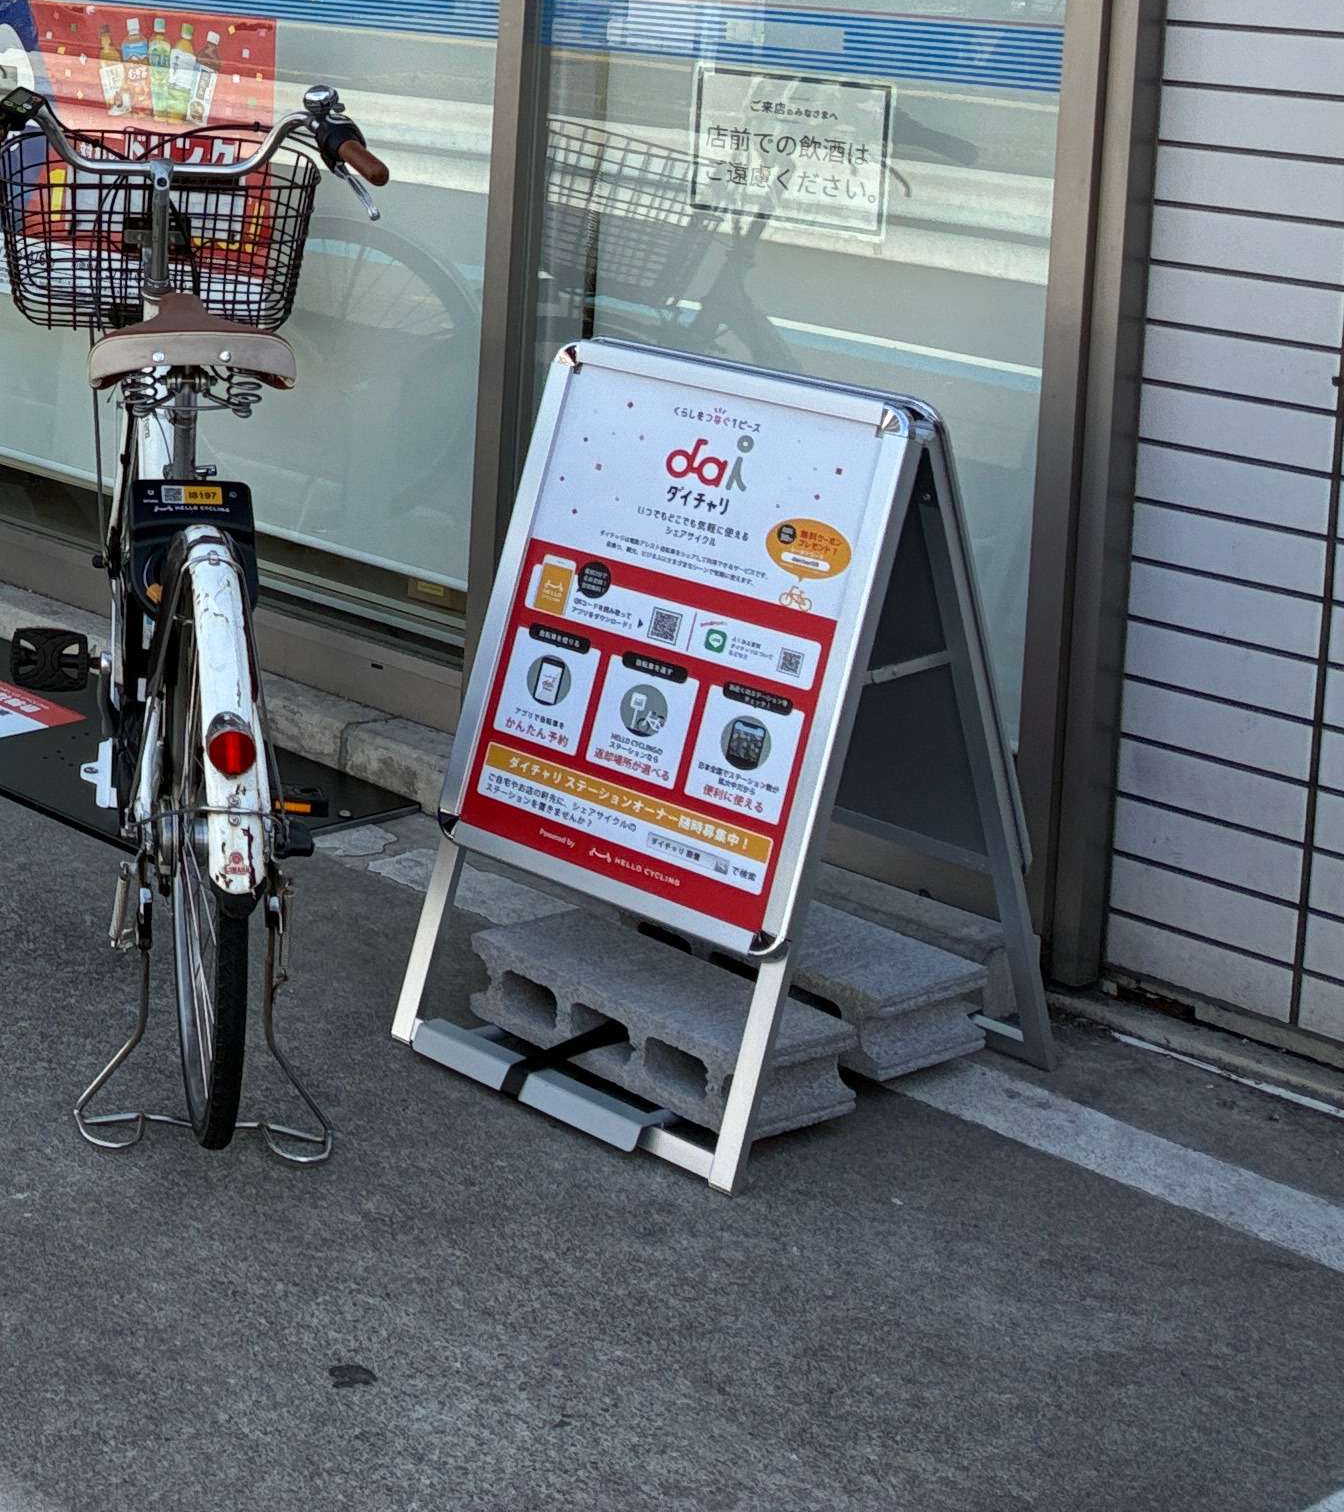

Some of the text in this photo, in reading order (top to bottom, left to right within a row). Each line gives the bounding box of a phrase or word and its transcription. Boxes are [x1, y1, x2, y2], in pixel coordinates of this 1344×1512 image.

[750, 100, 839, 121] ご来店のみなさまへ
[705, 124, 870, 166] 店前での飲酒は
[706, 159, 877, 204] ご遠慮ください。
[665, 434, 755, 492] dai
[665, 484, 730, 516] ダイチャリ
[637, 505, 750, 542] いつでもどこでも気軽に使える
[664, 526, 717, 547] シェアサイクル
[504, 717, 569, 748] かんたん予約
[509, 755, 562, 783] ダイチャリ
[593, 747, 670, 782] 返却場所が選べる
[702, 783, 764, 813] 便利に使える
[614, 856, 681, 887] HELLO CYCLING
